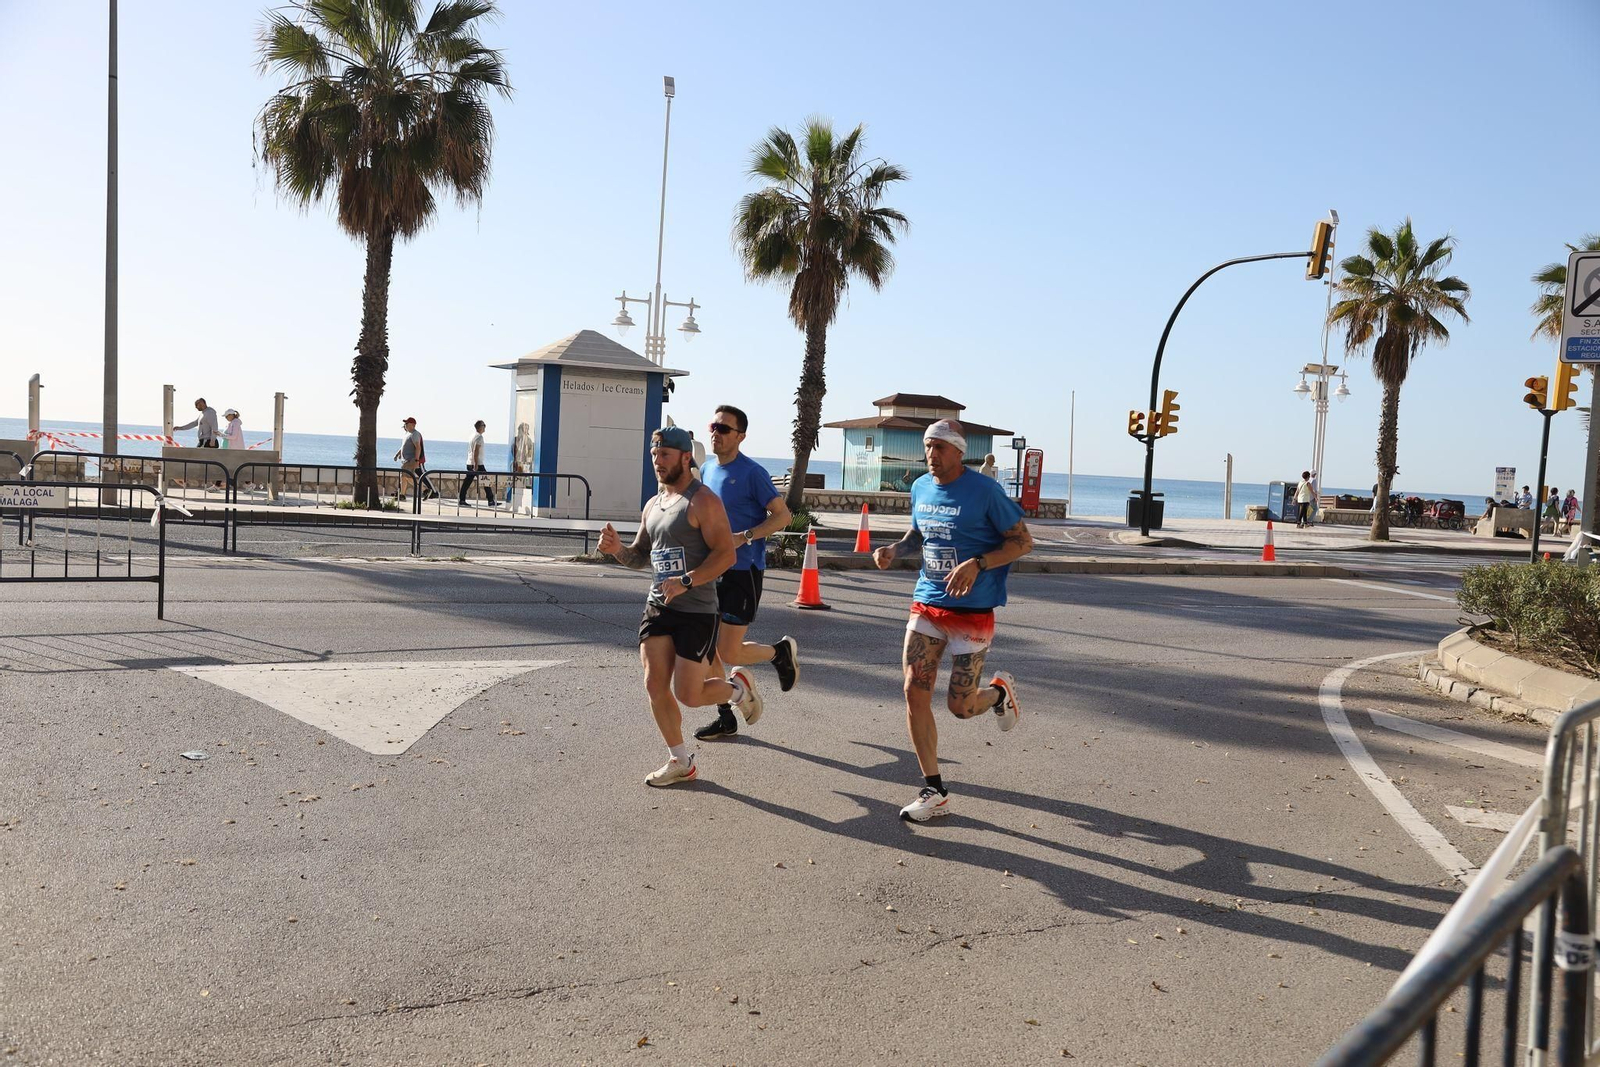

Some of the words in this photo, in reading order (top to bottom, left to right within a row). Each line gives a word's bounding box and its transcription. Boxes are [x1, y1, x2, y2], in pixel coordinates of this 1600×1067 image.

[563, 380, 595, 392] Helados
[602, 383, 614, 393] Ice
[615, 384, 644, 395] Creams
[23, 488, 55, 497] LOCAL
[917, 503, 962, 517] mayoral
